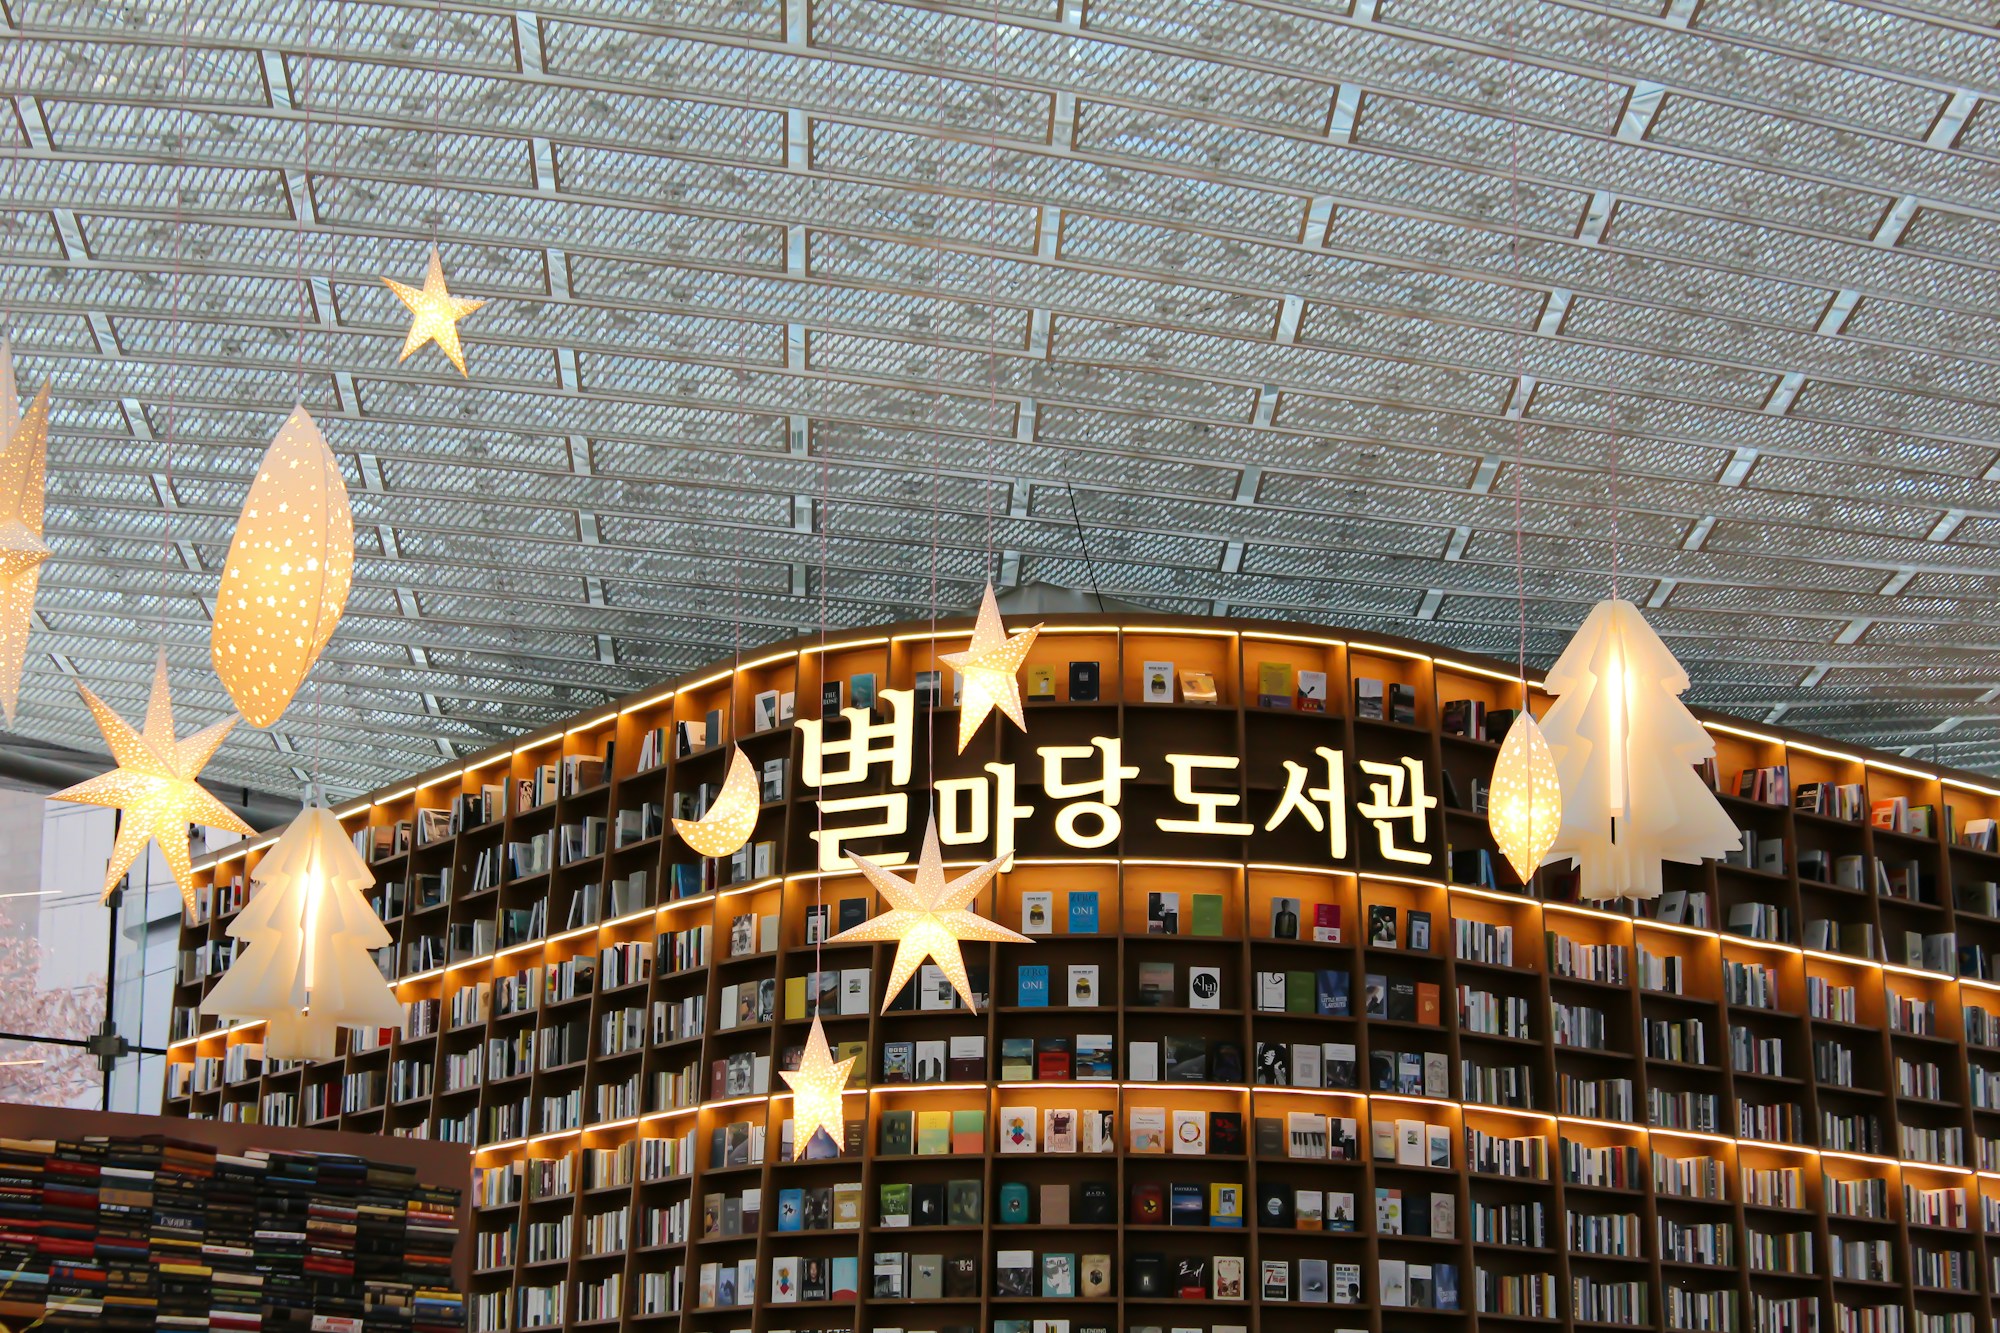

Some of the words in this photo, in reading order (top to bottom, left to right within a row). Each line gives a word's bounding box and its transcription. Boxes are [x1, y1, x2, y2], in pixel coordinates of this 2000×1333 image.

[793, 688, 1141, 874] 별마당
[1155, 746, 1438, 866] 도서관
[1070, 892, 1098, 902] ZERO
[1072, 906, 1095, 915] ONE
[1022, 980, 1044, 990] ONE
[763, 1013, 774, 1022] FAC
